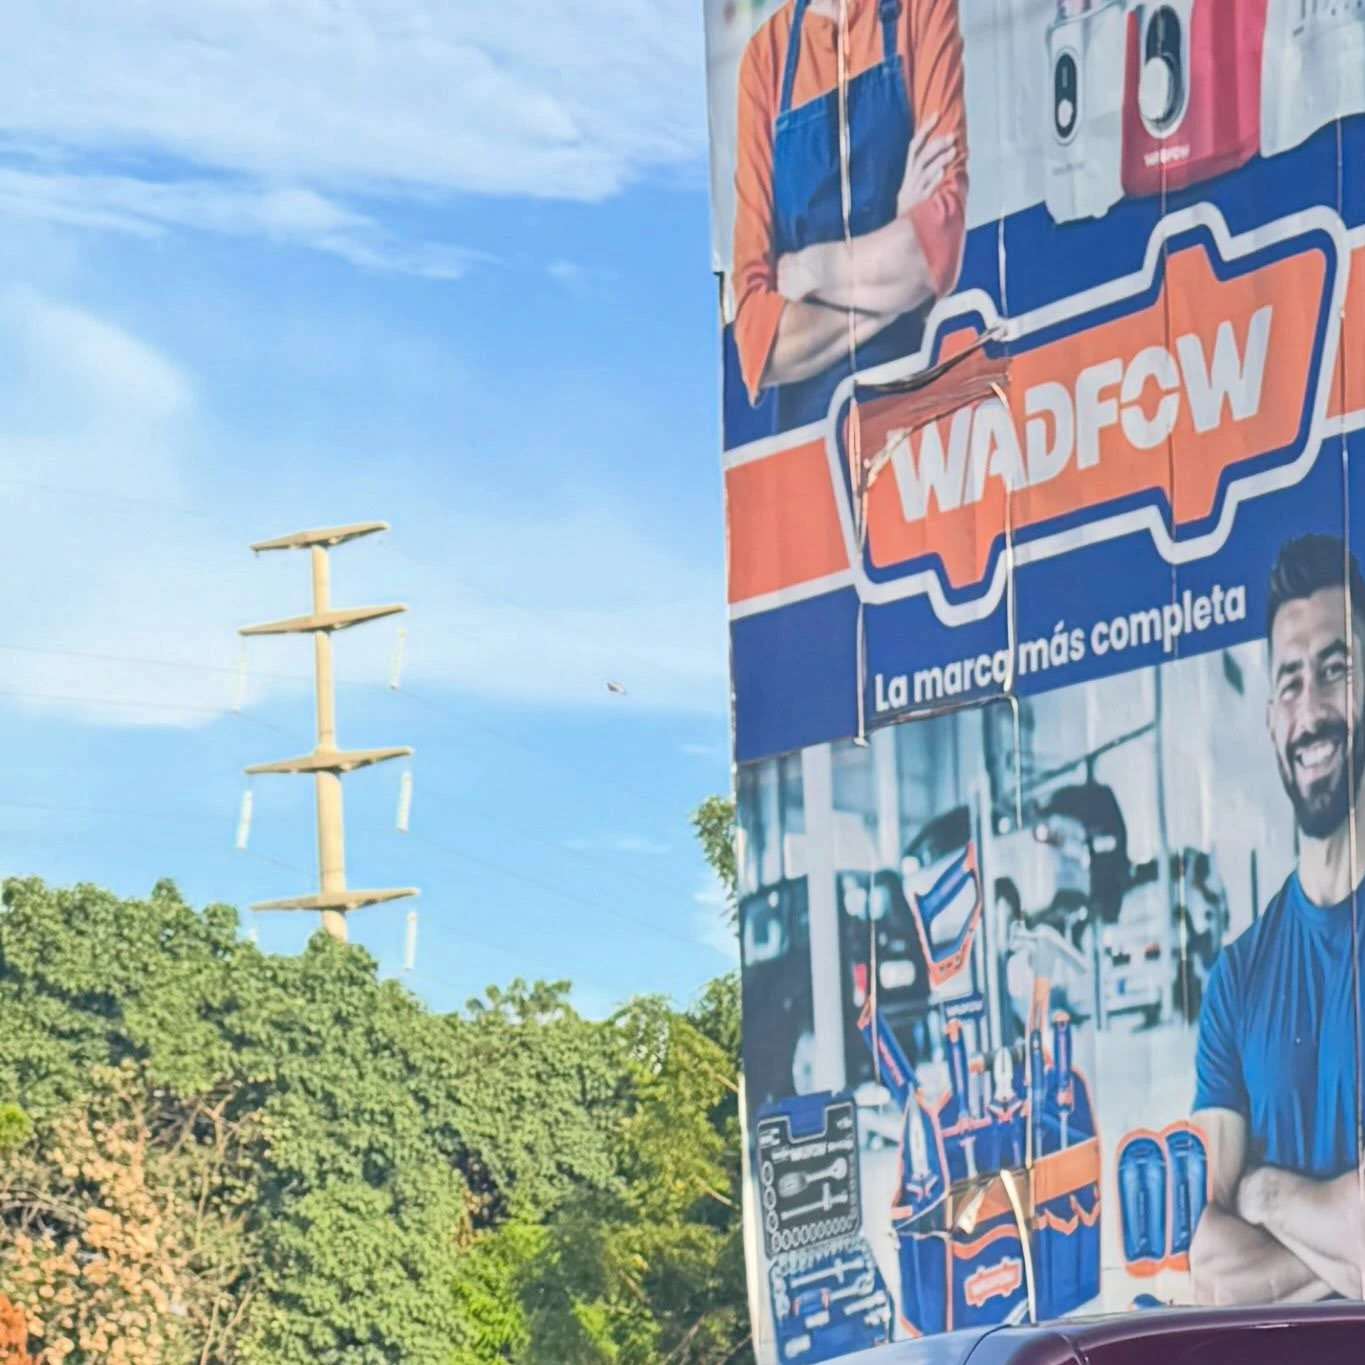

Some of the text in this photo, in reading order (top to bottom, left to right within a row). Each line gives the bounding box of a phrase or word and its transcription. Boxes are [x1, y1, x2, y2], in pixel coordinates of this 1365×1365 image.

[887, 304, 1273, 523] WADFOW
[875, 673, 907, 711] La
[1018, 620, 1086, 676] más
[1090, 583, 1247, 654] completa
